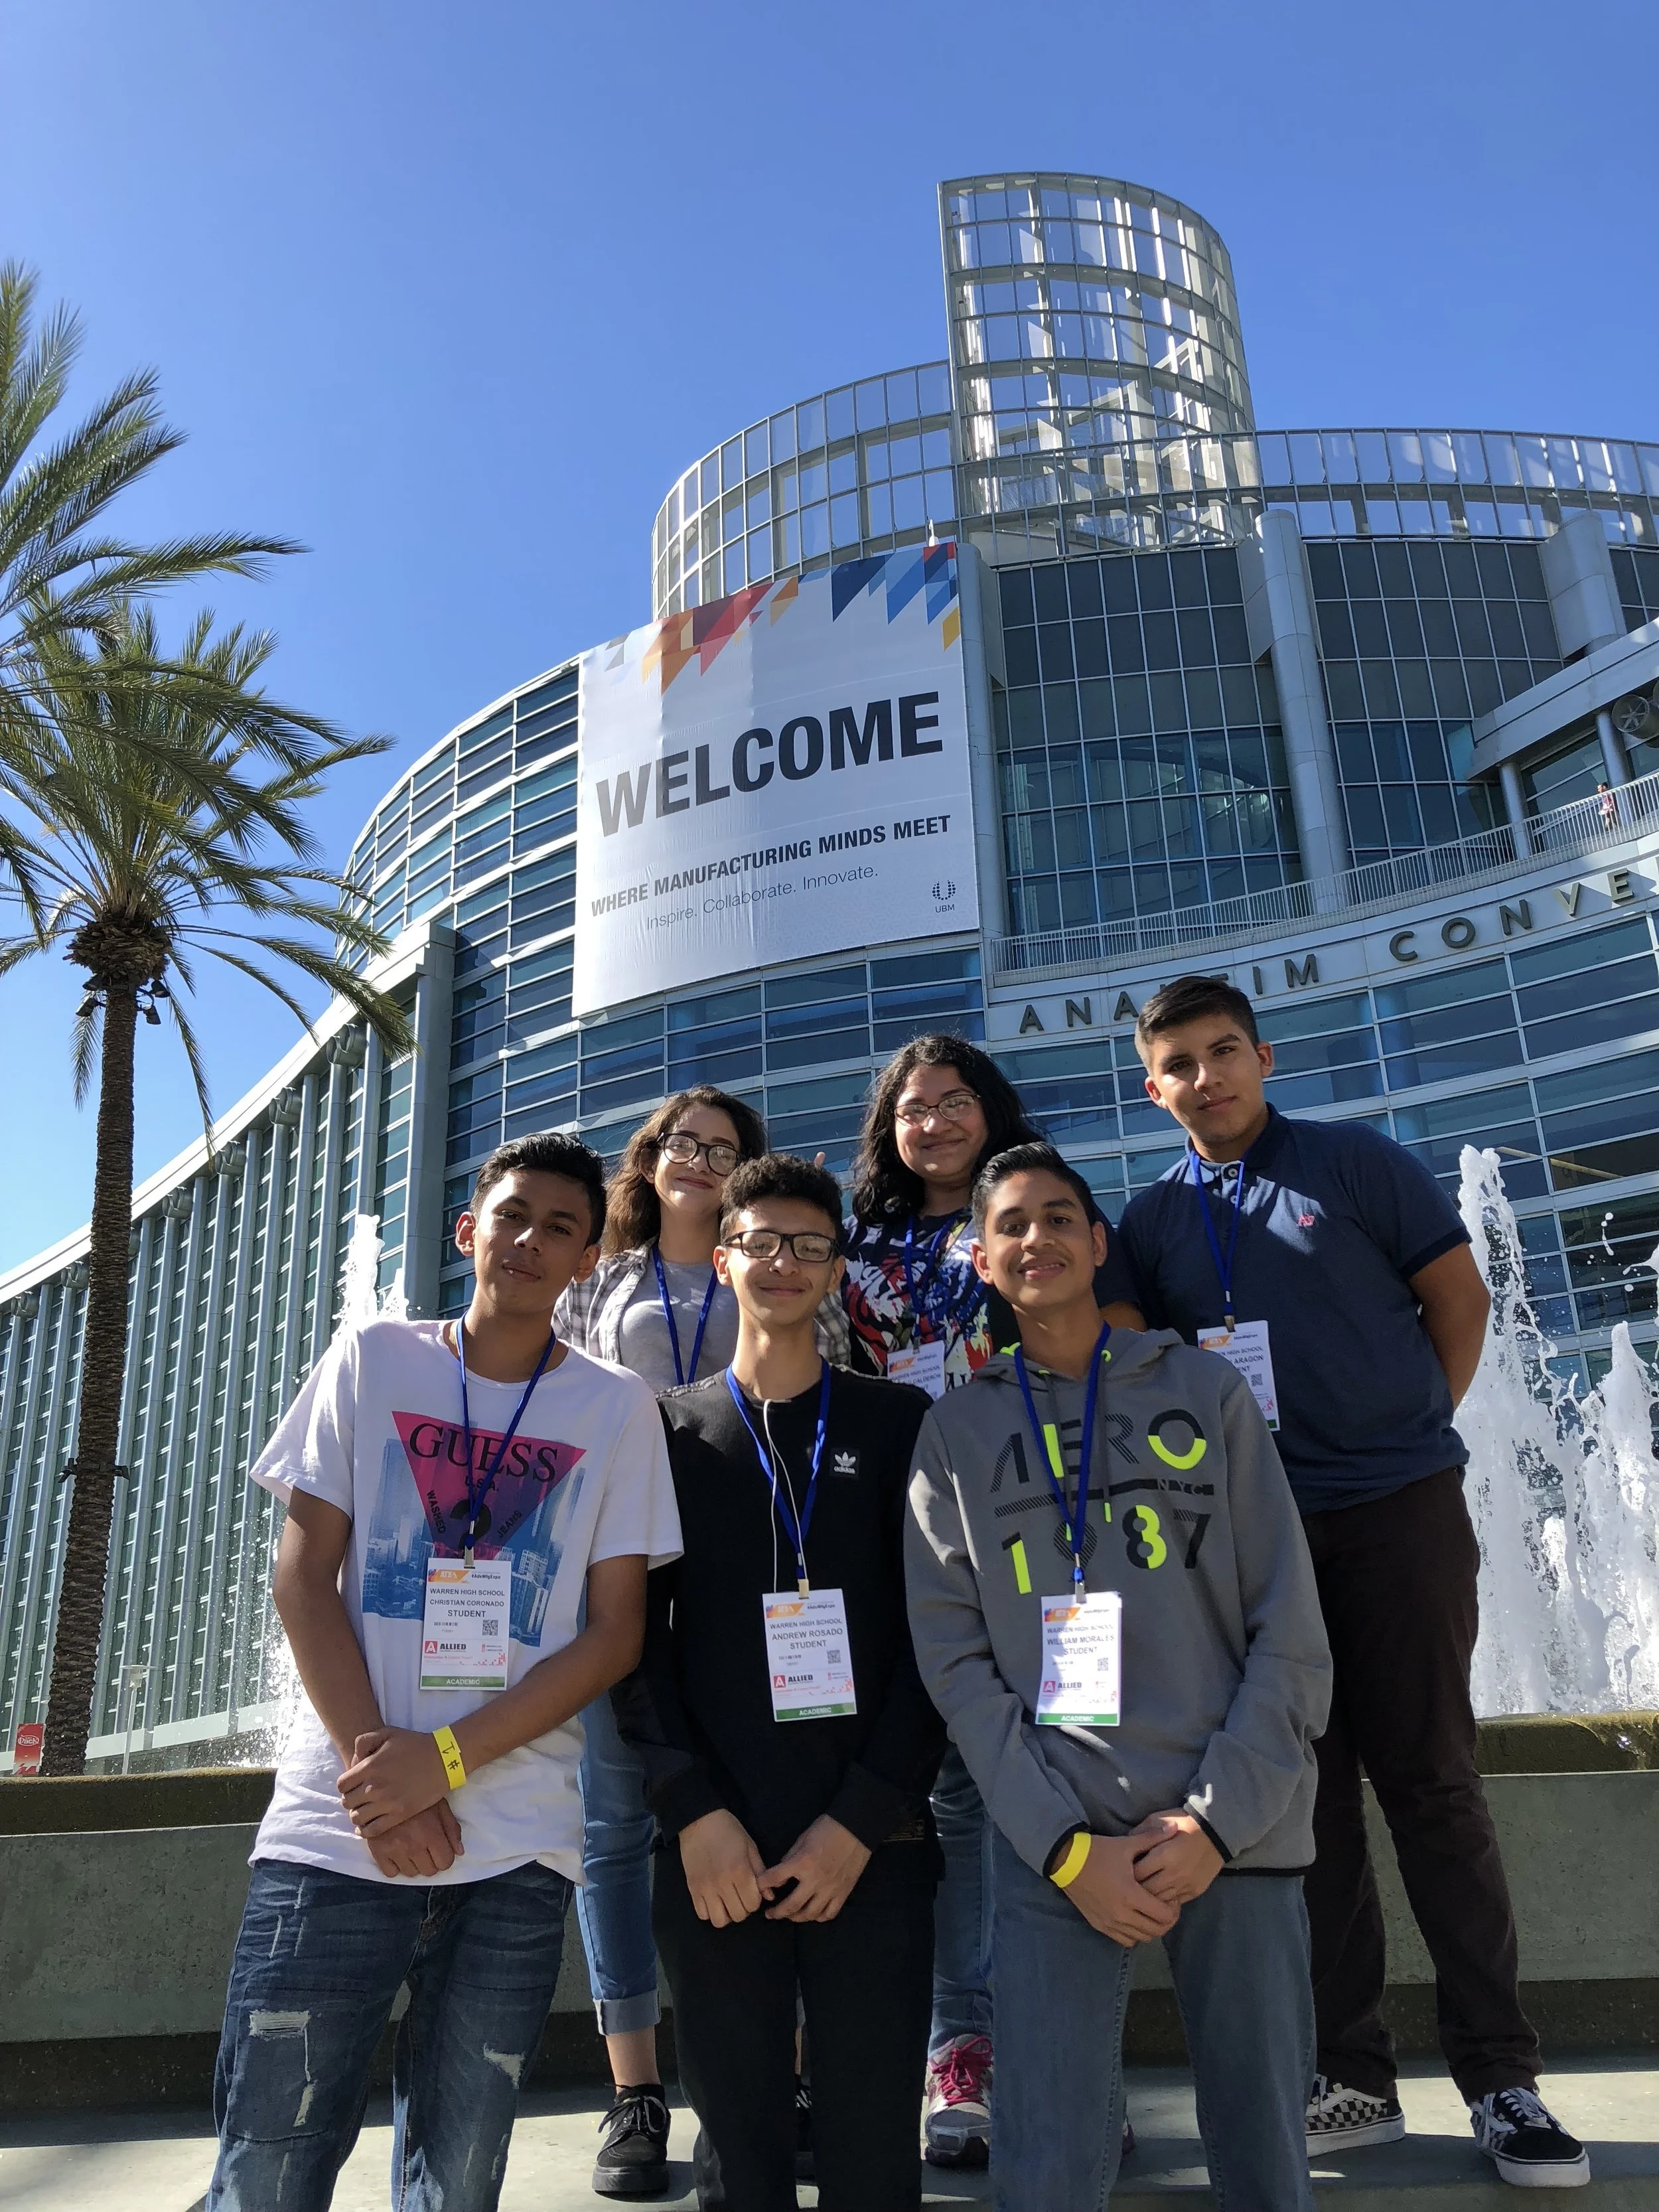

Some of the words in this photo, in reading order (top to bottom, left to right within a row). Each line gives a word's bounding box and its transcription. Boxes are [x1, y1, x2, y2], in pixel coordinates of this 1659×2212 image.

[596, 692, 944, 838] WELCOME
[591, 883, 648, 917] WHERE
[654, 840, 812, 897] MANUFACTURING
[818, 825, 886, 854] MINDS
[893, 814, 951, 840] MEET
[647, 906, 697, 930] Inspire.
[703, 883, 796, 913] Collaborate.
[803, 865, 879, 890] Innovate.
[935, 903, 955, 913] UBM
[1019, 954, 1319, 1034] ANAIM
[1234, 1355, 1264, 1364] ARAGON
[409, 1423, 559, 1483] GUESS
[991, 1408, 1207, 1493] AERO
[427, 1490, 447, 1534] WASHED
[497, 1509, 522, 1538] JEANS
[447, 1609, 486, 1618] STUDENT
[772, 1630, 807, 1641] ANDREW
[809, 1627, 843, 1637] ROSADO
[1080, 1635, 1114, 1643] MORALES
[790, 1640, 827, 1650] STUDENT
[1064, 1647, 1098, 1655] STUDENT
[799, 1708, 831, 1716] ACADEMIC
